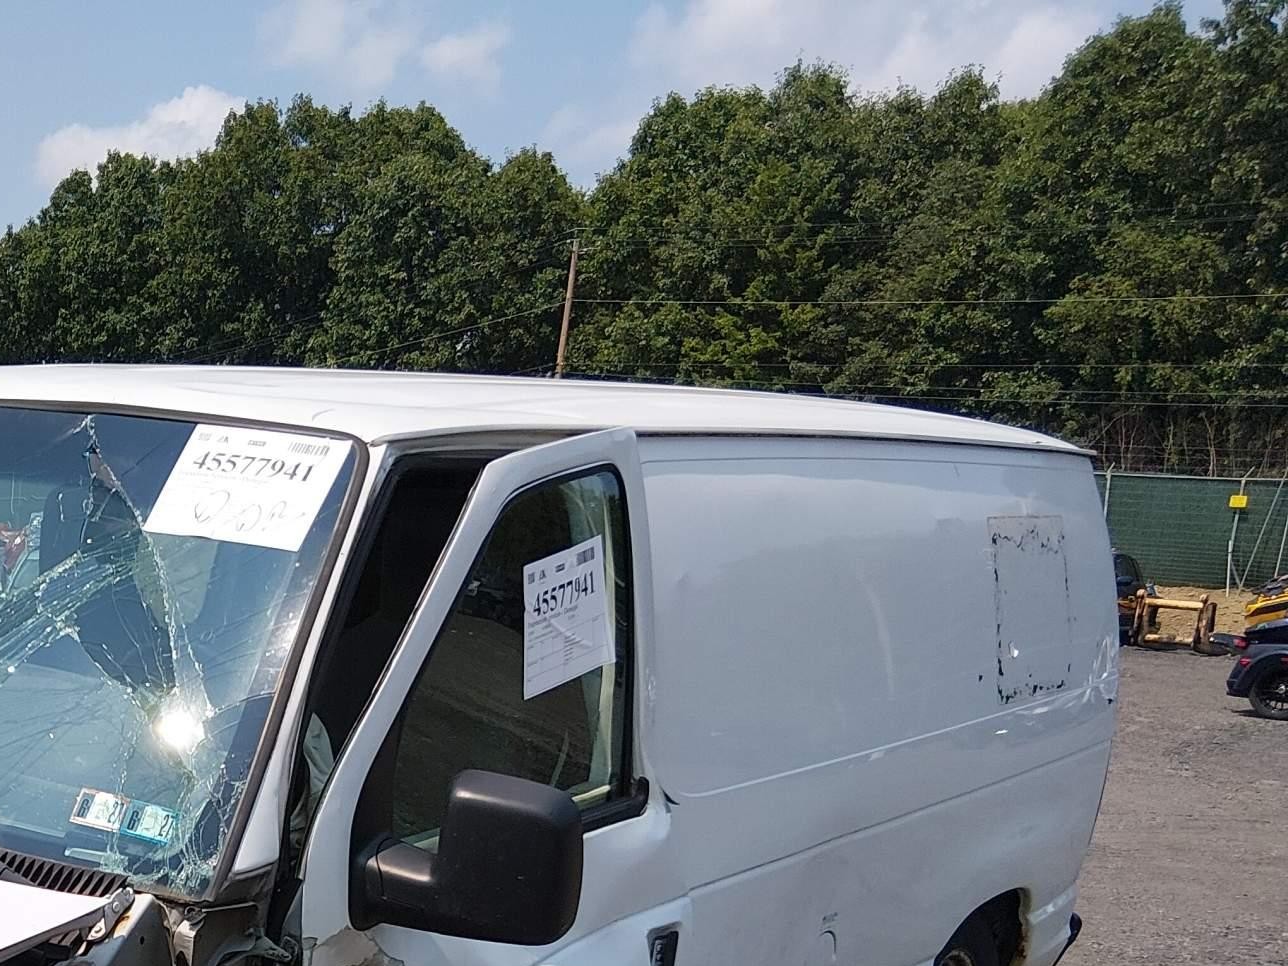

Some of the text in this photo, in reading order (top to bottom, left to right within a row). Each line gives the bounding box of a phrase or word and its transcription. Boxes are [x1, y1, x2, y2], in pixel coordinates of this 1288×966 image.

[192, 450, 314, 482] 45577941
[533, 570, 596, 616] 45577941
[78, 798, 90, 818] 6
[127, 810, 140, 830] 6
